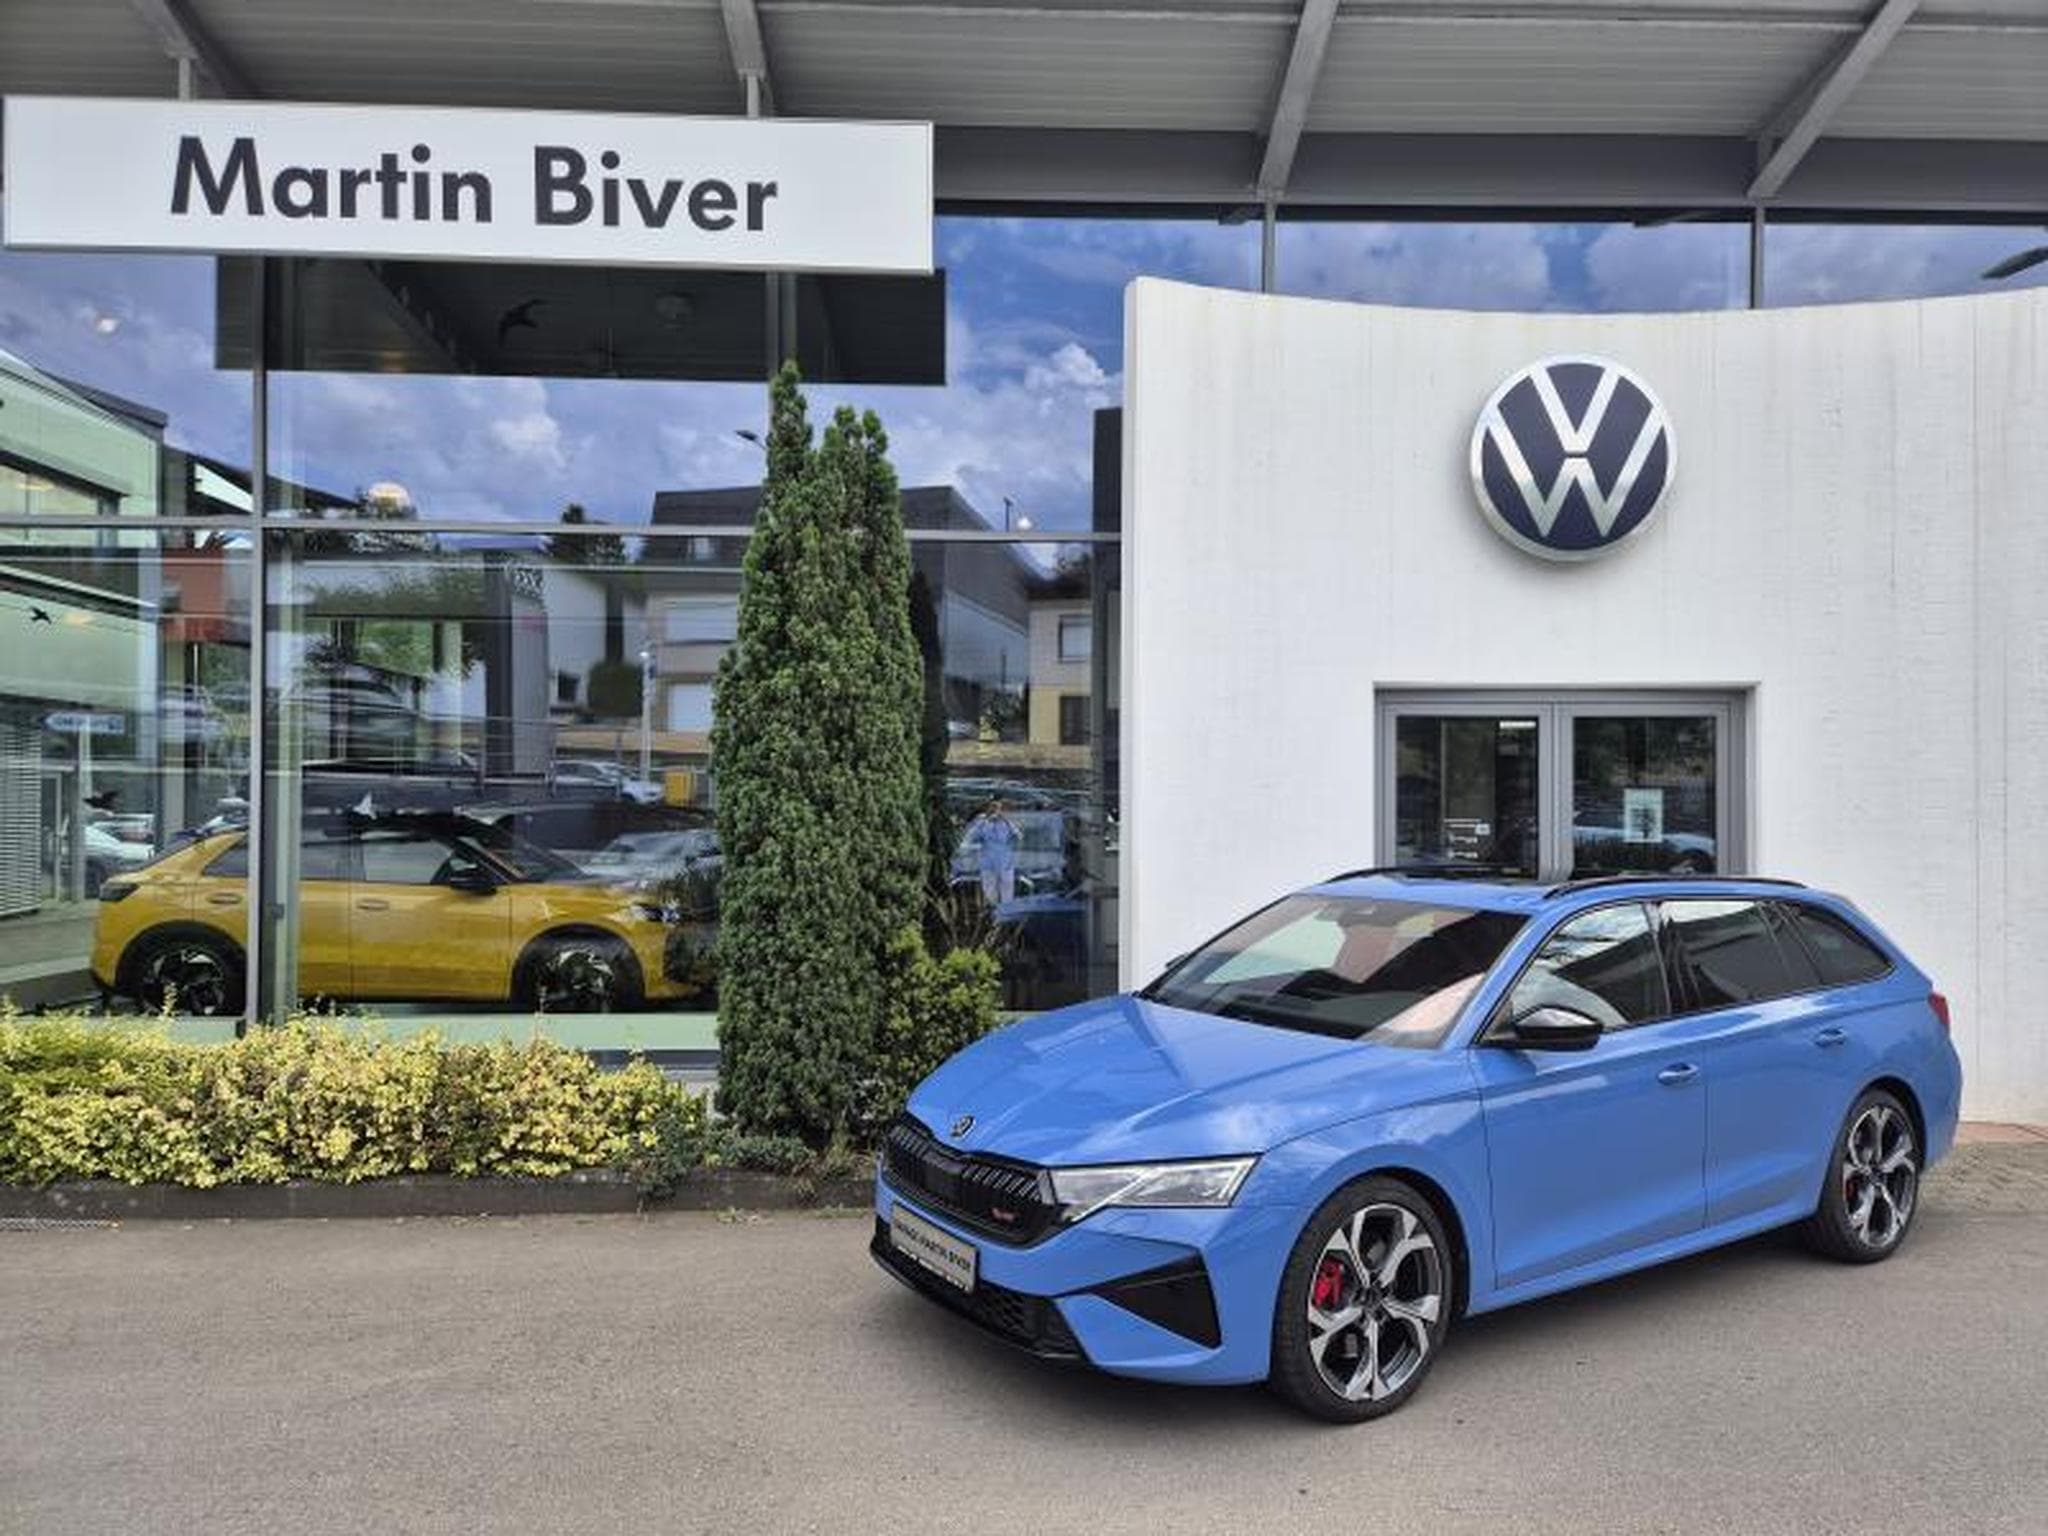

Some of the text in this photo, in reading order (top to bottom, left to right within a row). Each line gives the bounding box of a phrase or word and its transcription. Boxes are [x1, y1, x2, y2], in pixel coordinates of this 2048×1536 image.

[170, 136, 779, 232] Martin Biver
[1473, 357, 1673, 548] VW
